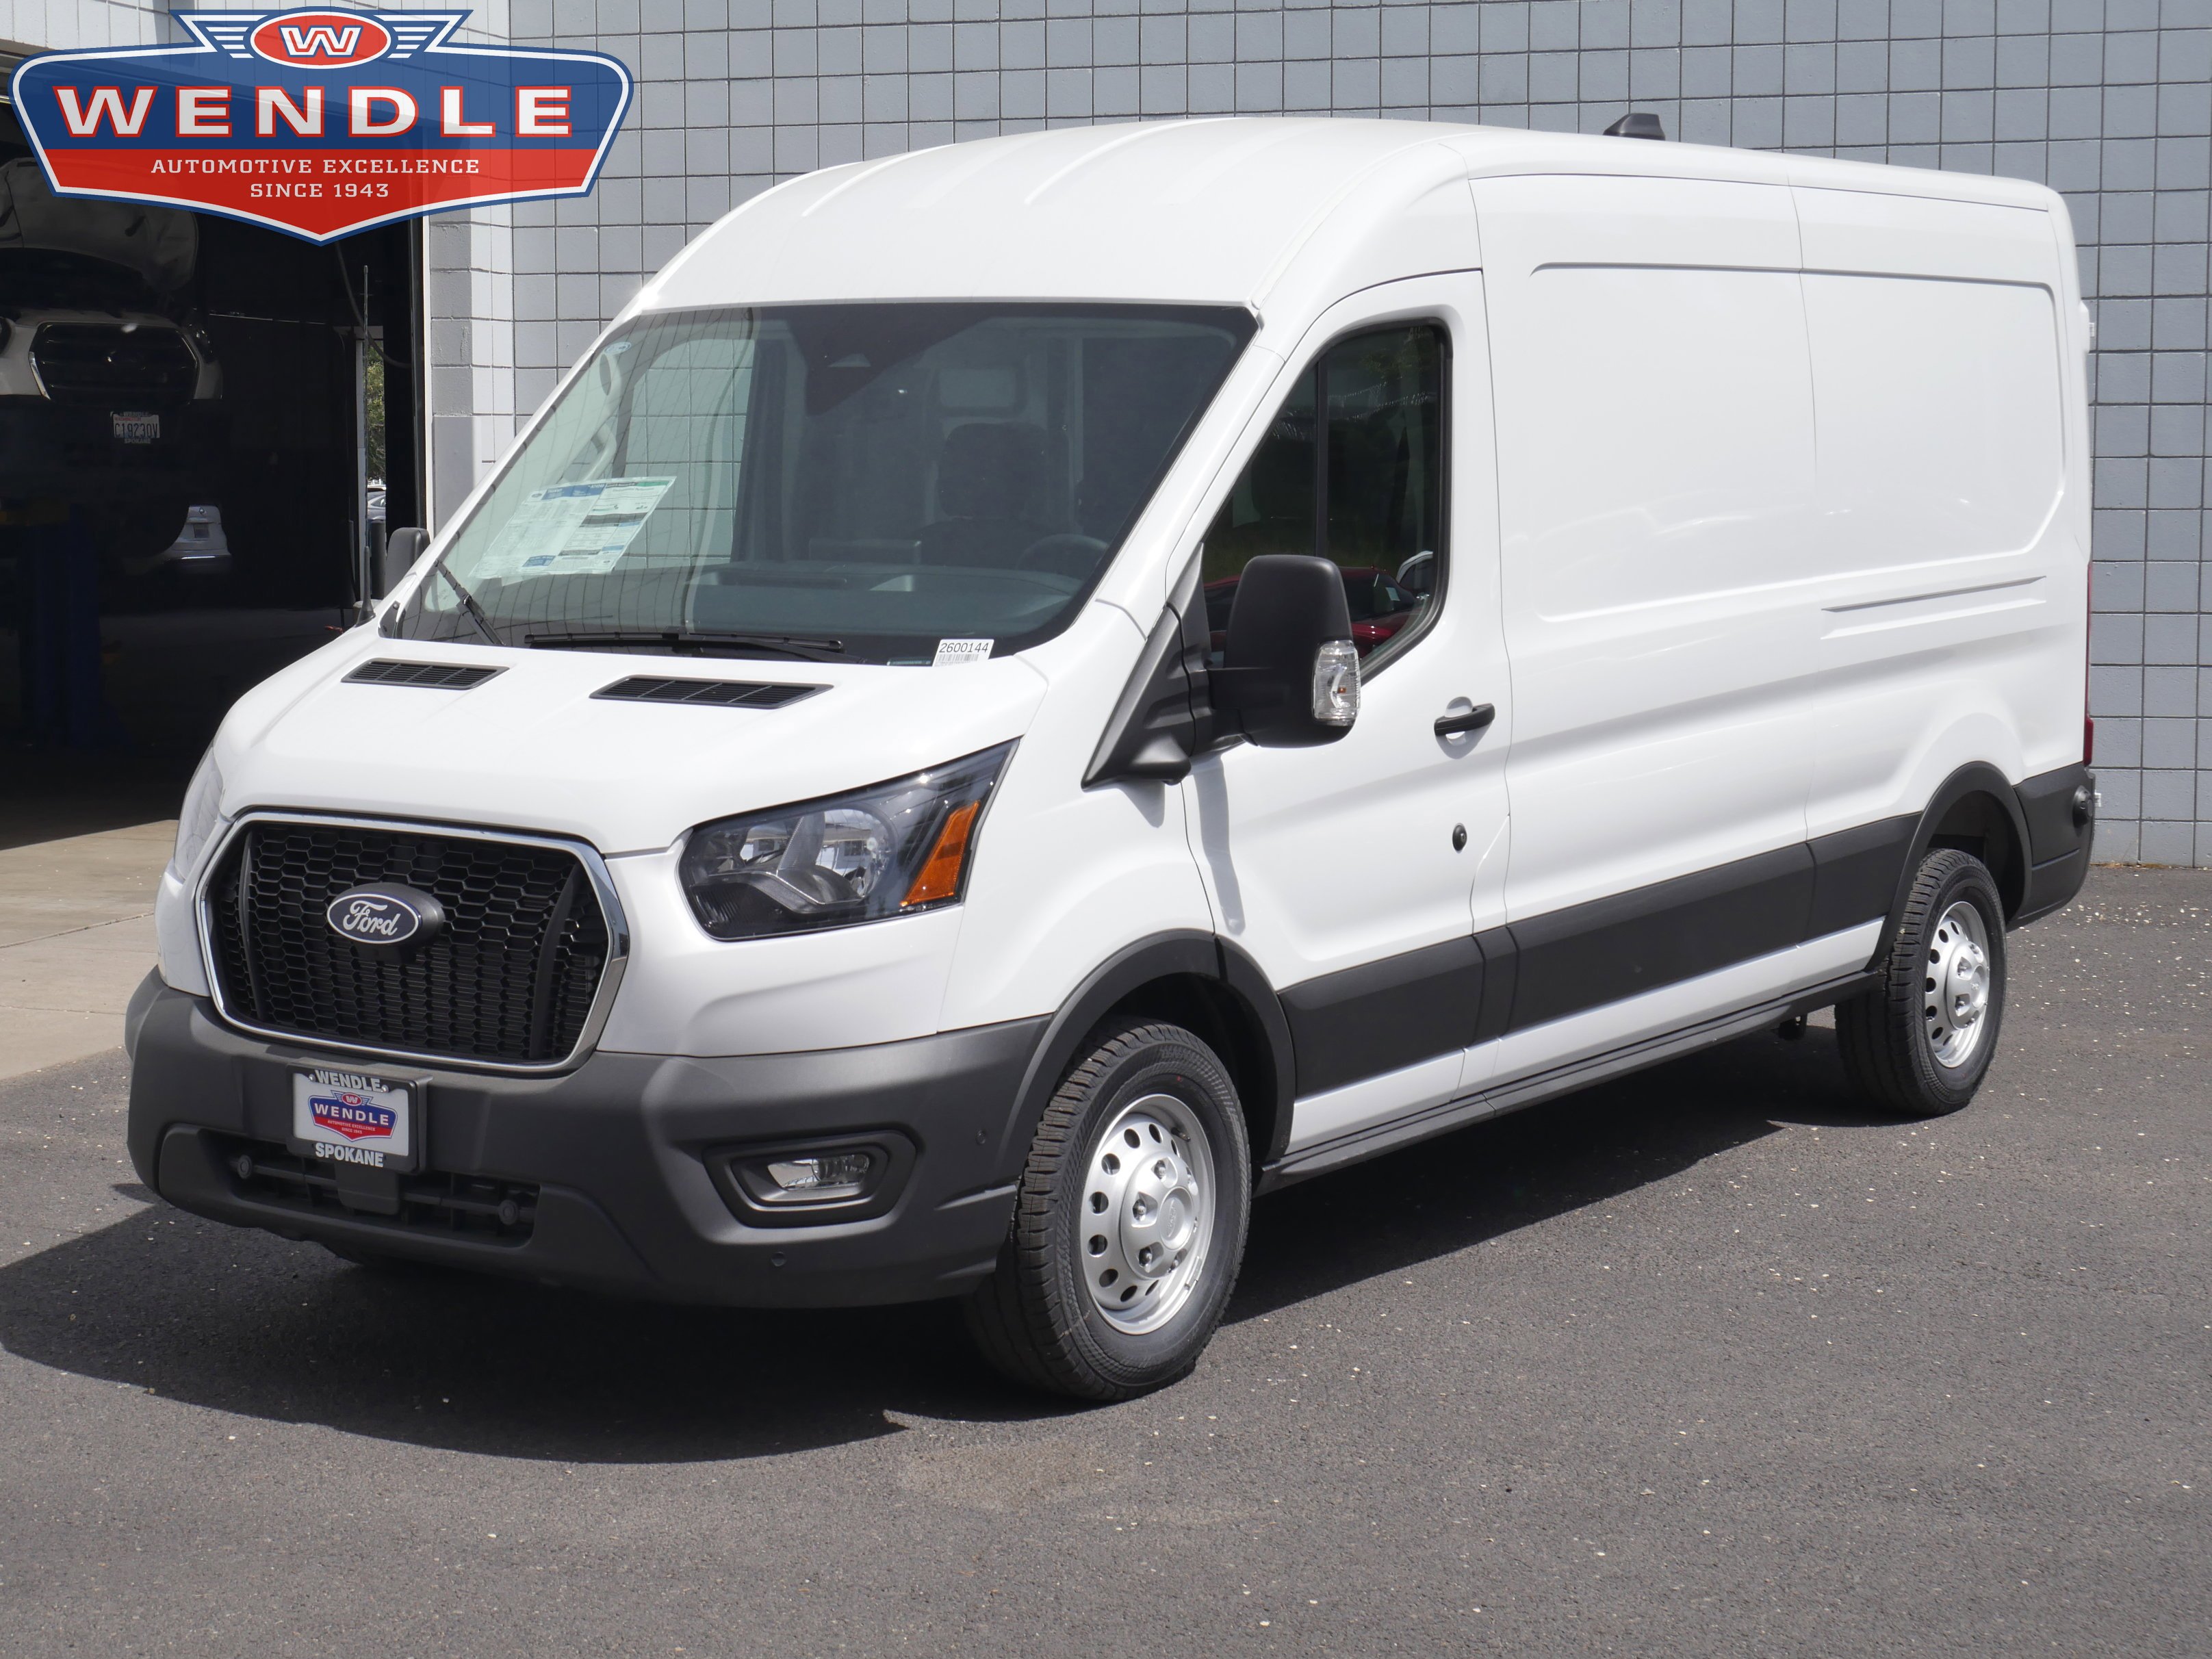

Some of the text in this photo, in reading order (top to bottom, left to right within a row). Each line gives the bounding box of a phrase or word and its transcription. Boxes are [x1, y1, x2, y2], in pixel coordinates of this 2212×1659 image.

[114, 423, 158, 438] C19230V
[938, 642, 989, 653] 2600144
[343, 900, 401, 936] Ford
[314, 1069, 382, 1092] WENDLE
[314, 1103, 389, 1126] WENDLE
[315, 1142, 384, 1168] SPOKANE
